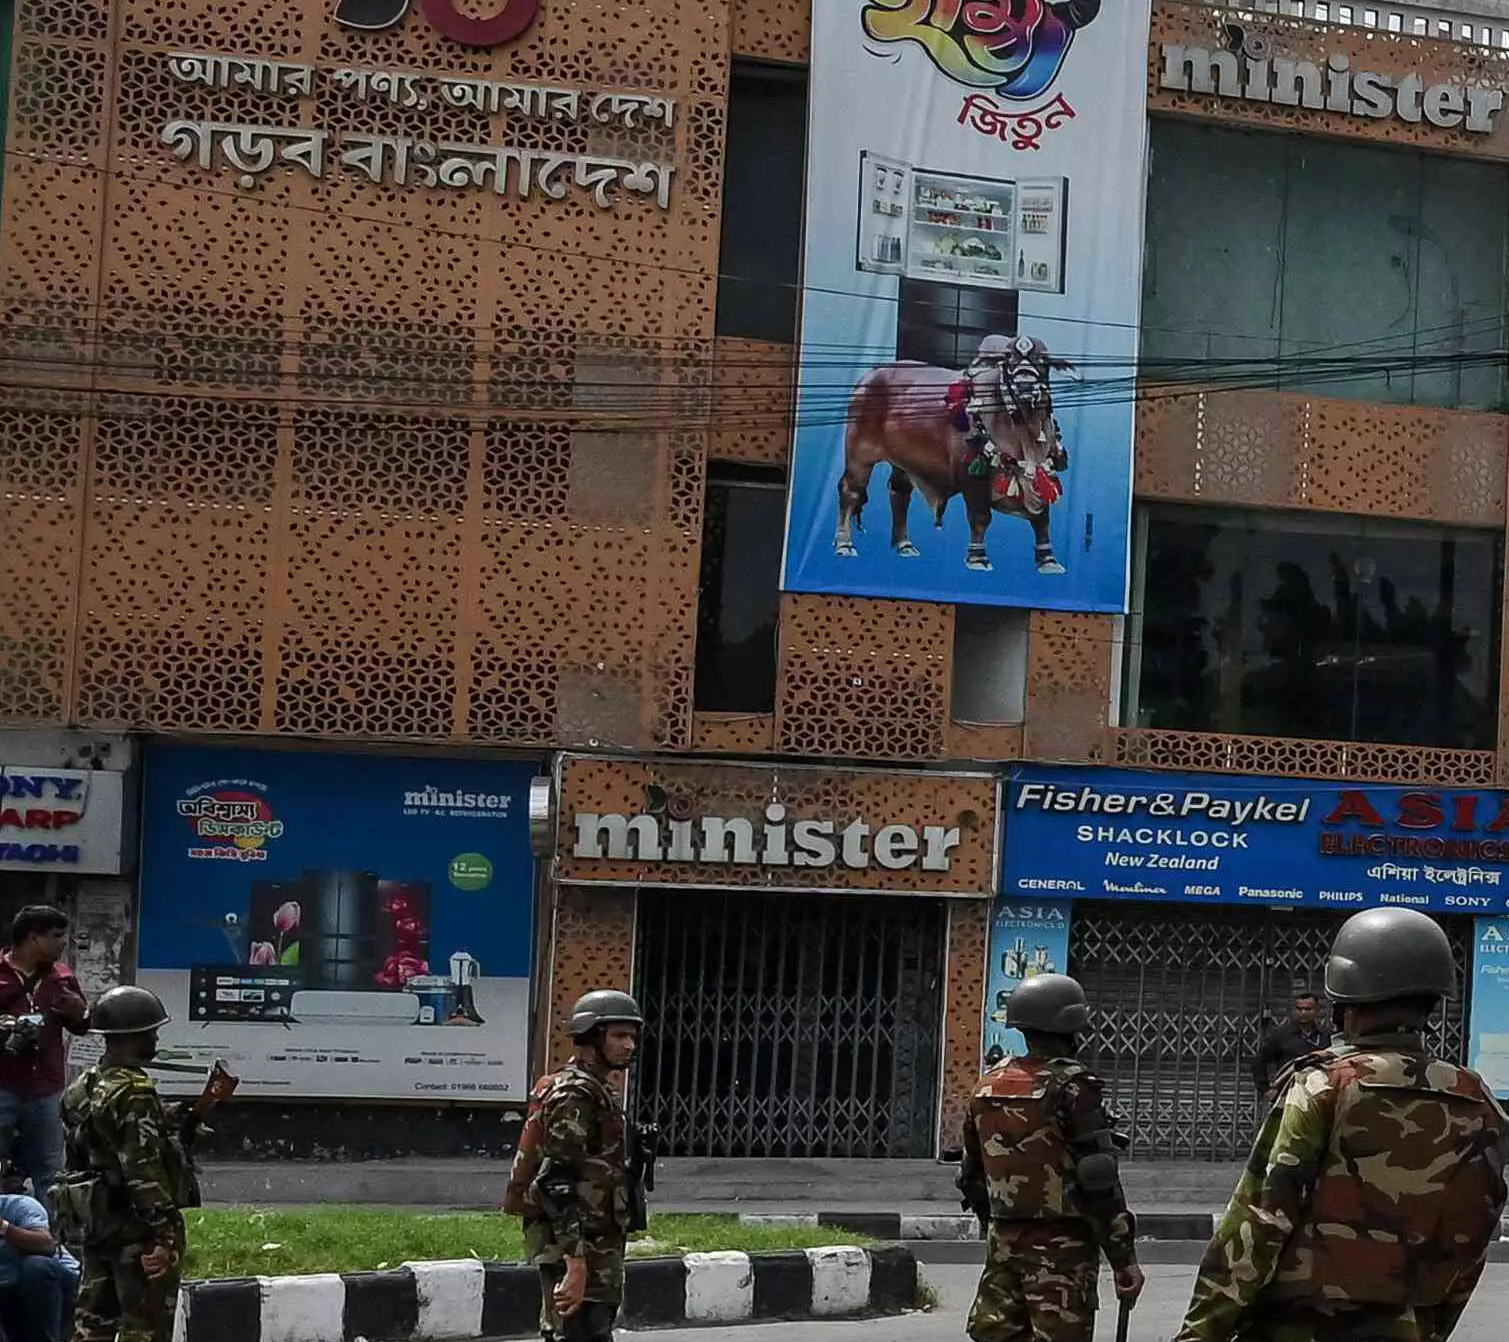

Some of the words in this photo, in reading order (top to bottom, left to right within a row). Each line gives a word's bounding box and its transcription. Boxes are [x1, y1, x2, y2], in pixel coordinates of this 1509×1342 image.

[166, 52, 317, 96] আমার
[440, 77, 581, 121] আমার
[590, 92, 676, 130] দেশ
[1160, 25, 1505, 135] minister
[956, 92, 1077, 151] জিতুন
[342, 136, 676, 210] বাংলাদেশ
[403, 785, 512, 809] minister
[573, 785, 961, 873] minister
[1076, 824, 1249, 849] SHACKLOCK
[1104, 851, 1145, 868] New
[1146, 854, 1220, 871] Zealand
[1367, 863, 1419, 882] এশিয়া
[1018, 878, 1086, 891] GENERAL
[1184, 885, 1221, 896] MEGA
[1238, 885, 1304, 900] Panasonic
[1318, 891, 1364, 902] PHILIPS
[1379, 892, 1430, 905] National
[1445, 896, 1492, 907] SONY
[997, 905, 1064, 920] ASIA
